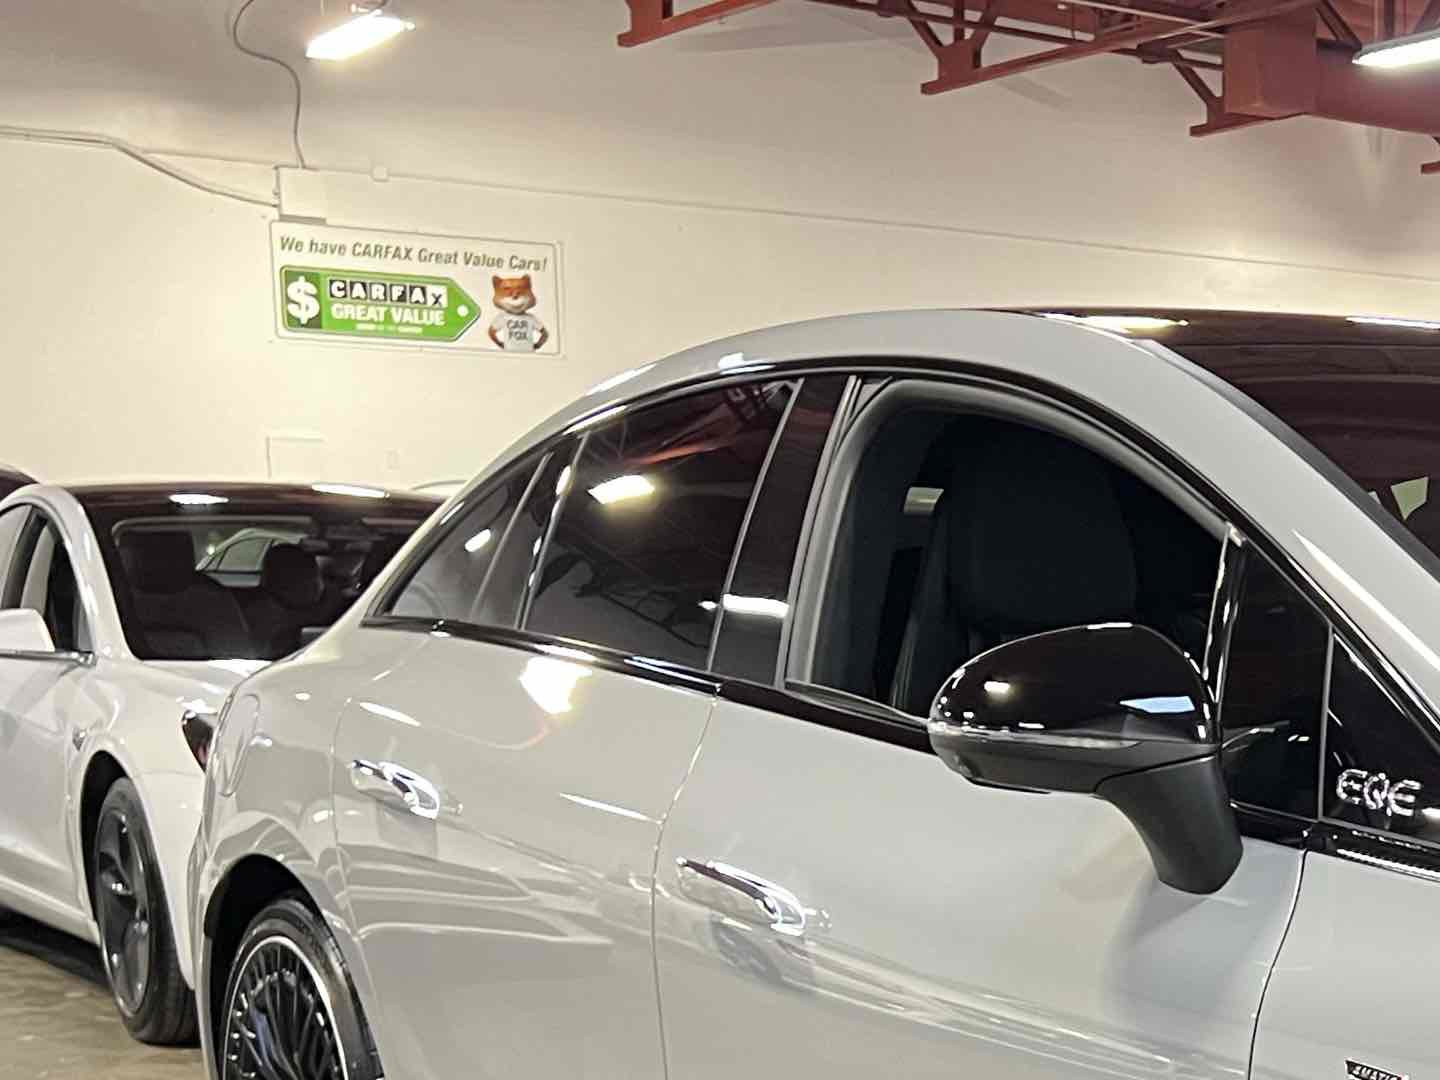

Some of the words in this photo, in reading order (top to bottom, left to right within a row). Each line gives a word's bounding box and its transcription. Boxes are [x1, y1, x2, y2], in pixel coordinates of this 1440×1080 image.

[279, 236, 304, 252] We
[308, 238, 347, 257] have
[351, 243, 414, 262] CARFAX
[417, 248, 459, 266] Great
[463, 252, 505, 269] Value
[508, 256, 548, 272] Cars!
[329, 279, 447, 307] CARFAX
[331, 303, 388, 323] GREAT
[390, 307, 446, 326] VALUE
[1336, 768, 1422, 817] EQE
